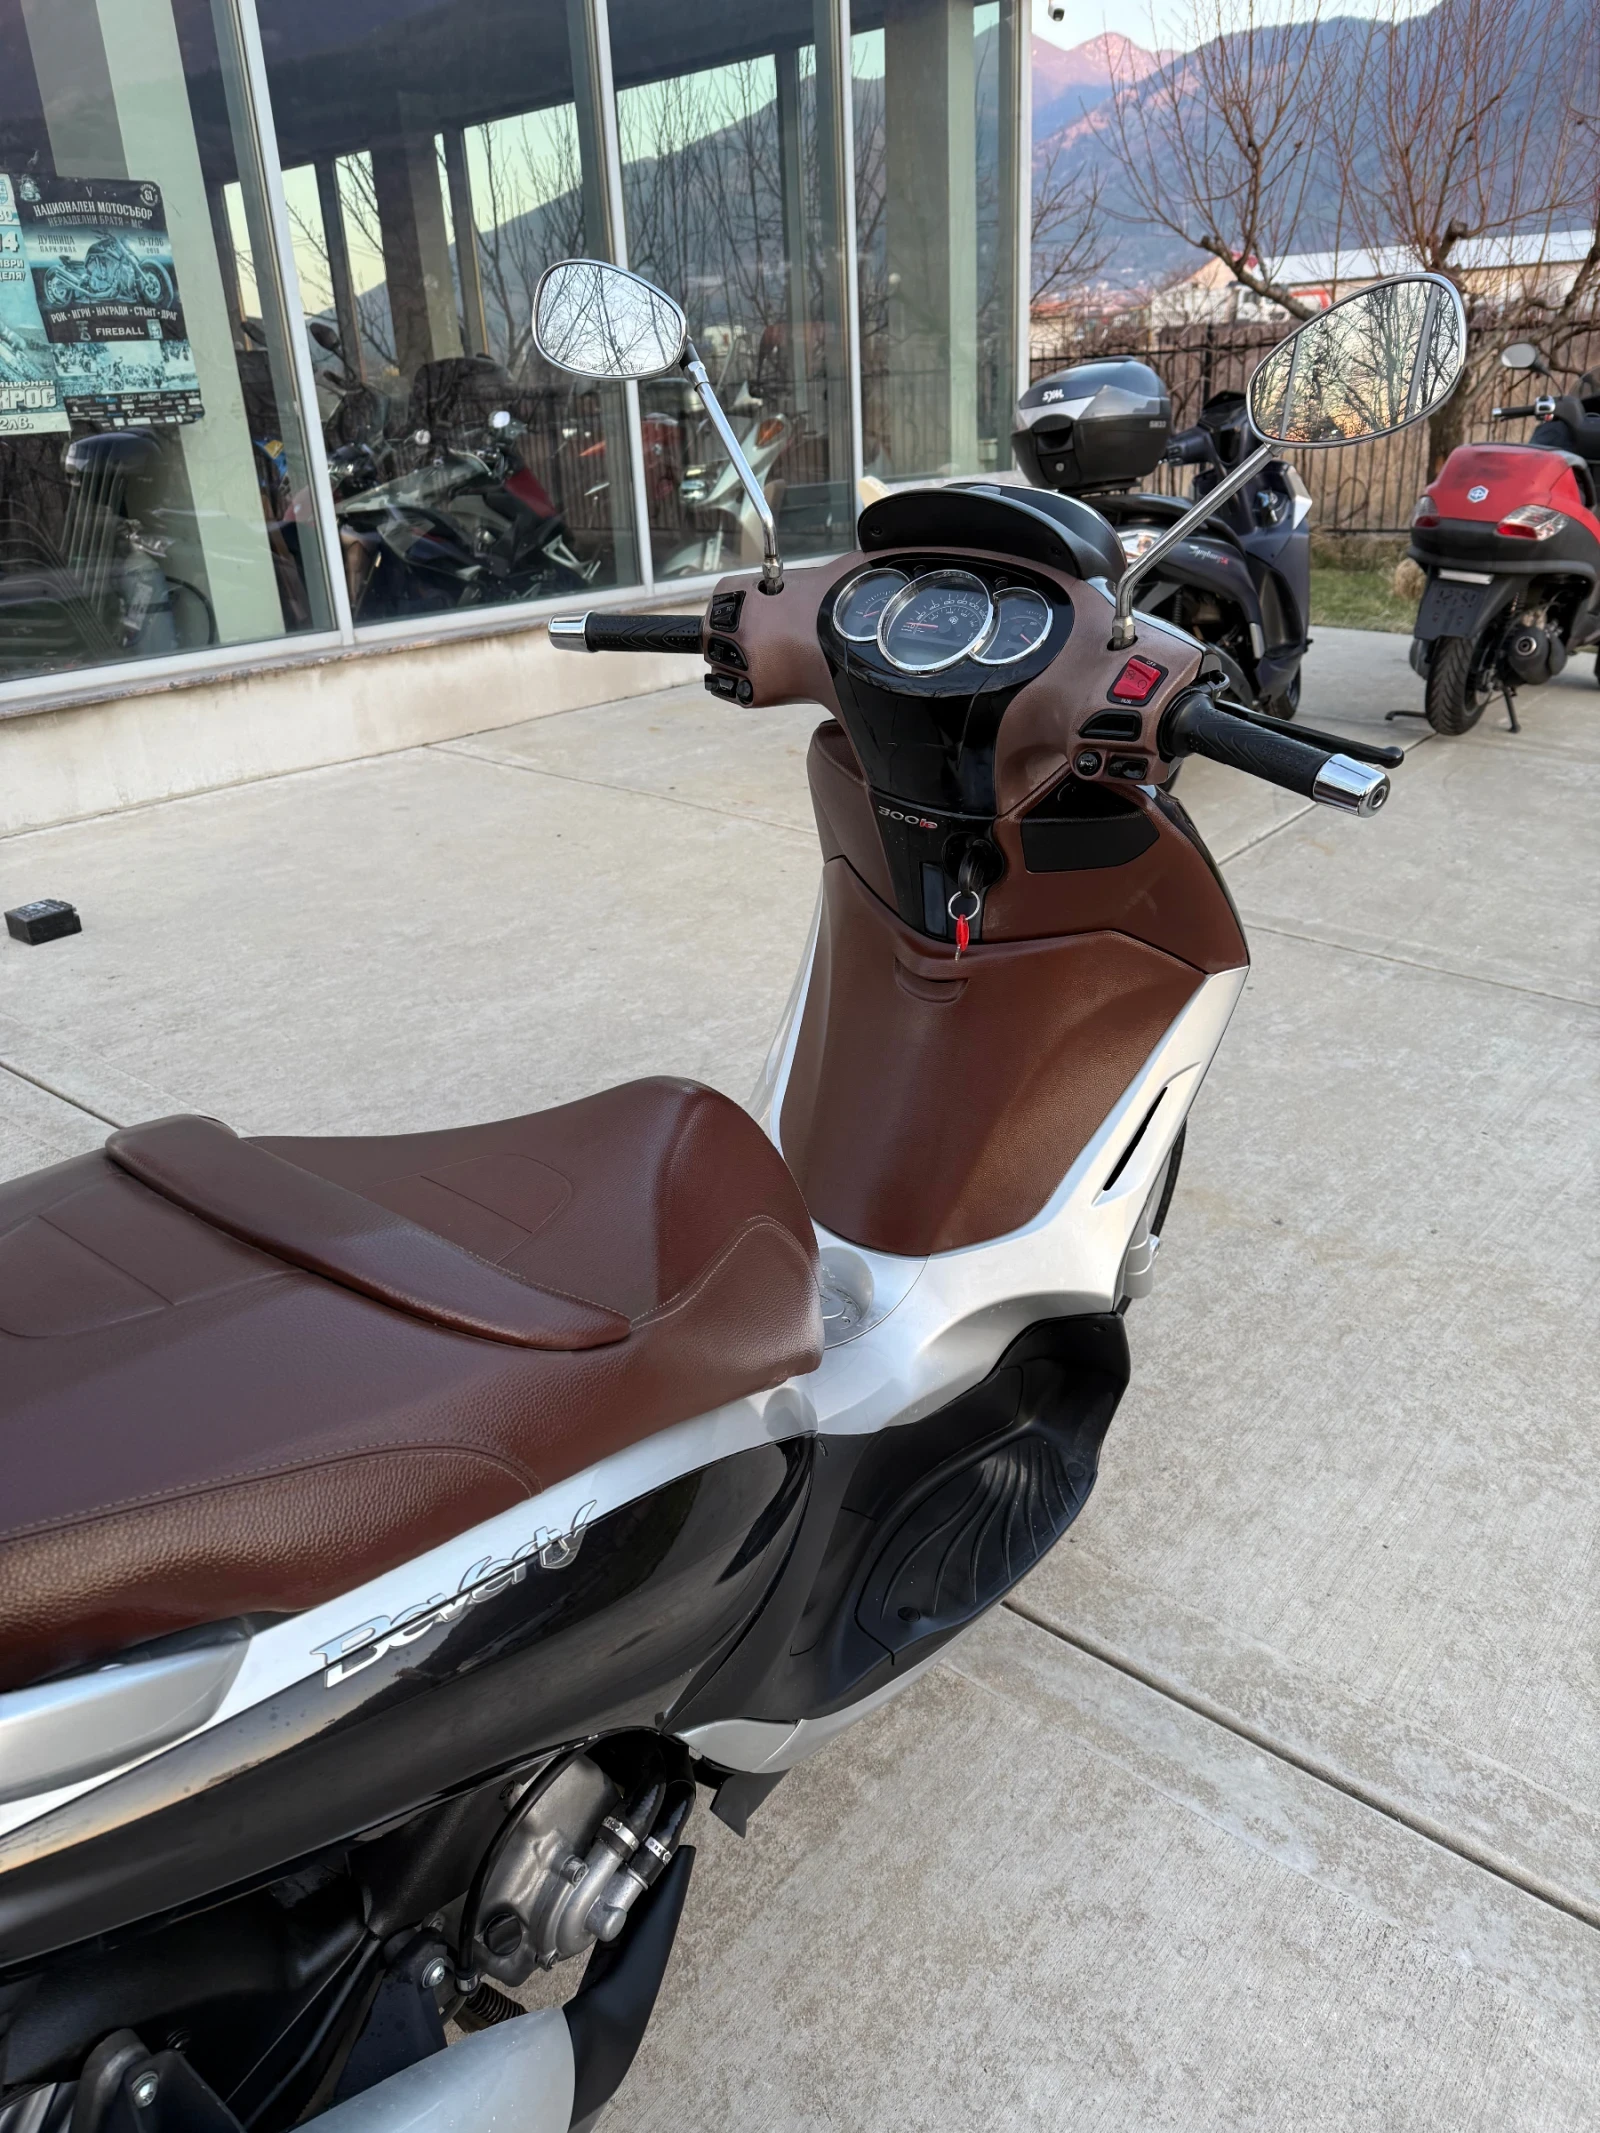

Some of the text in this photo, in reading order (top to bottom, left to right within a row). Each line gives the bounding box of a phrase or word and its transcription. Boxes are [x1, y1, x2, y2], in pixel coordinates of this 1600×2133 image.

[33, 201, 153, 220] НАЦИОНАЛЕН МОТОСЪБОР
[47, 214, 98, 228] НЕРАЗДЕЛНИ
[99, 214, 124, 227] БРАТЯ
[0, 231, 20, 253] 4
[37, 234, 76, 246] ДУПНИЦА
[50, 311, 68, 323] РОК
[71, 308, 91, 319] ИГРИ
[95, 305, 129, 317] НАГРАДИ
[133, 306, 156, 318] СТЪНТ
[95, 327, 145, 337] FIREBALL
[309, 1499, 597, 1689] Beverly
